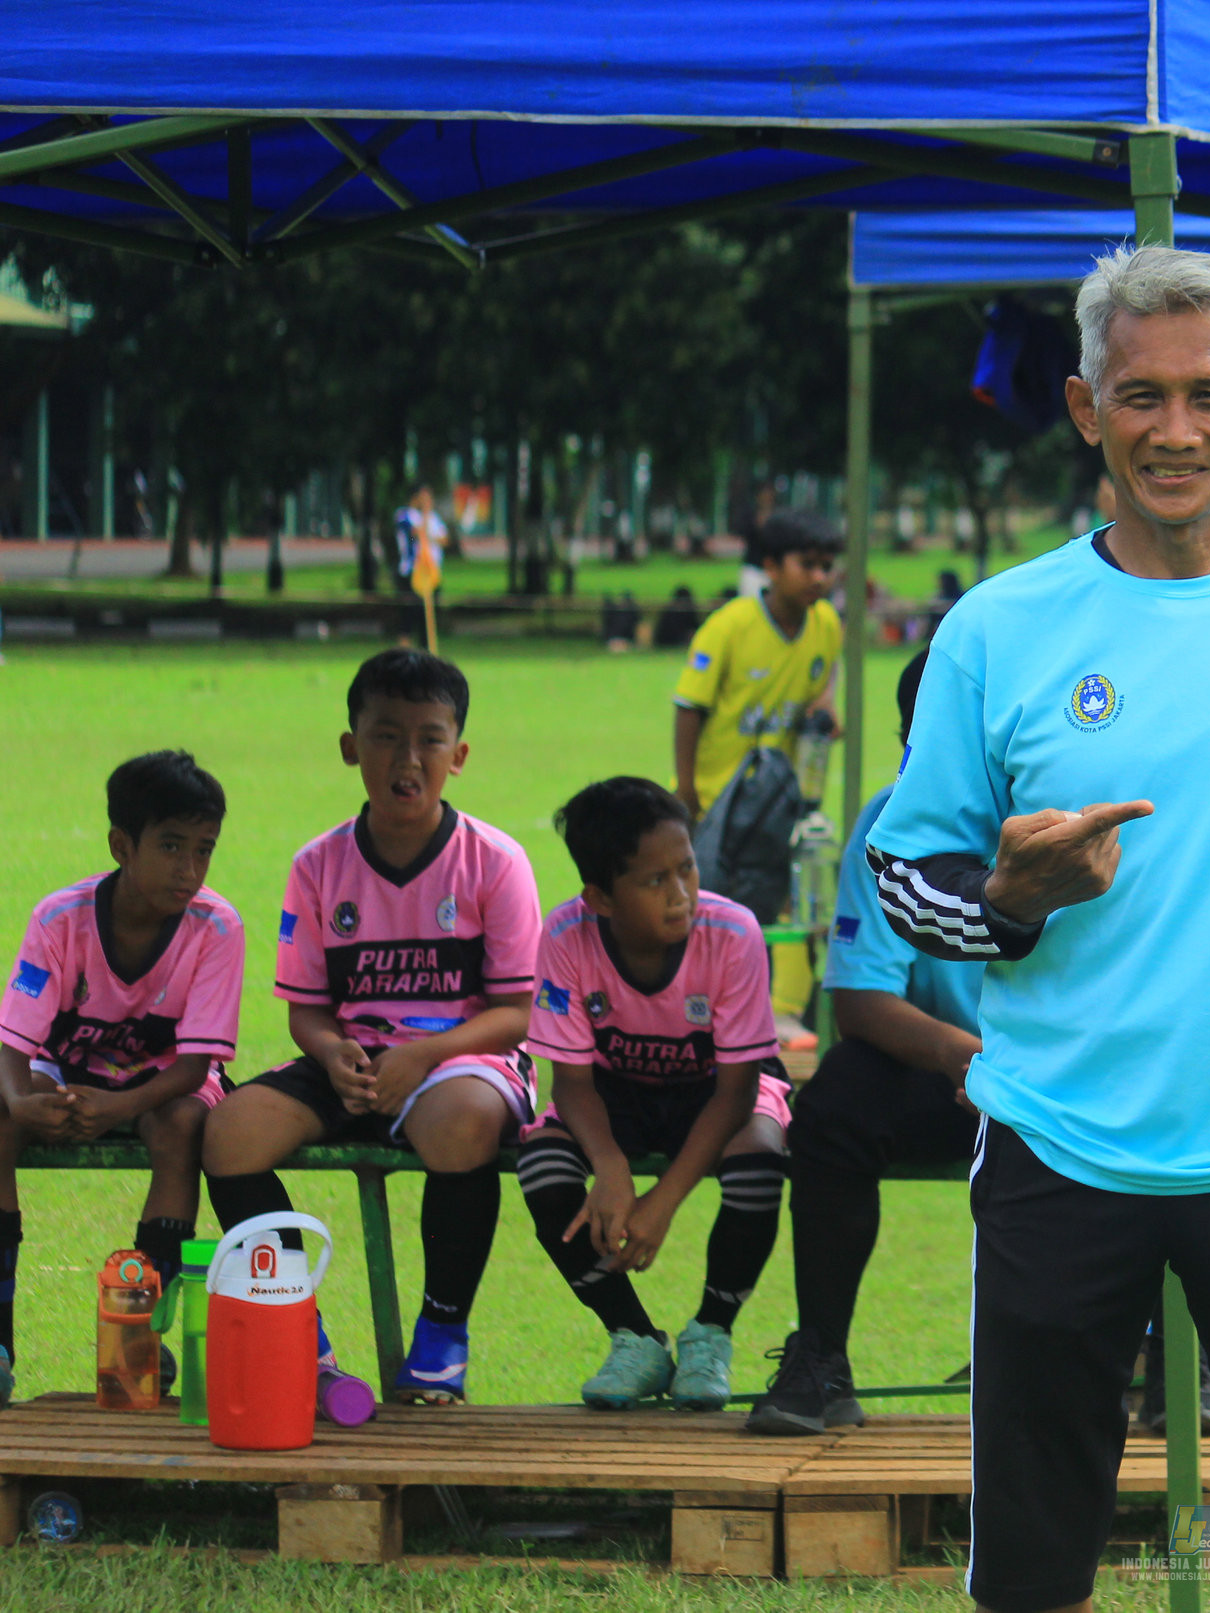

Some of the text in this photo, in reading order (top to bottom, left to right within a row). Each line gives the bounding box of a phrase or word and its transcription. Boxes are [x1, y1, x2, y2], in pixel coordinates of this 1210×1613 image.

[1083, 685, 1102, 695] PSSI
[1098, 721, 1112, 732] PSSI
[1111, 694, 1125, 722] JAKARTA
[356, 947, 438, 972] PUTRA
[608, 1034, 697, 1060] PUTRA
[250, 1286, 304, 1295] Nautic 2.0
